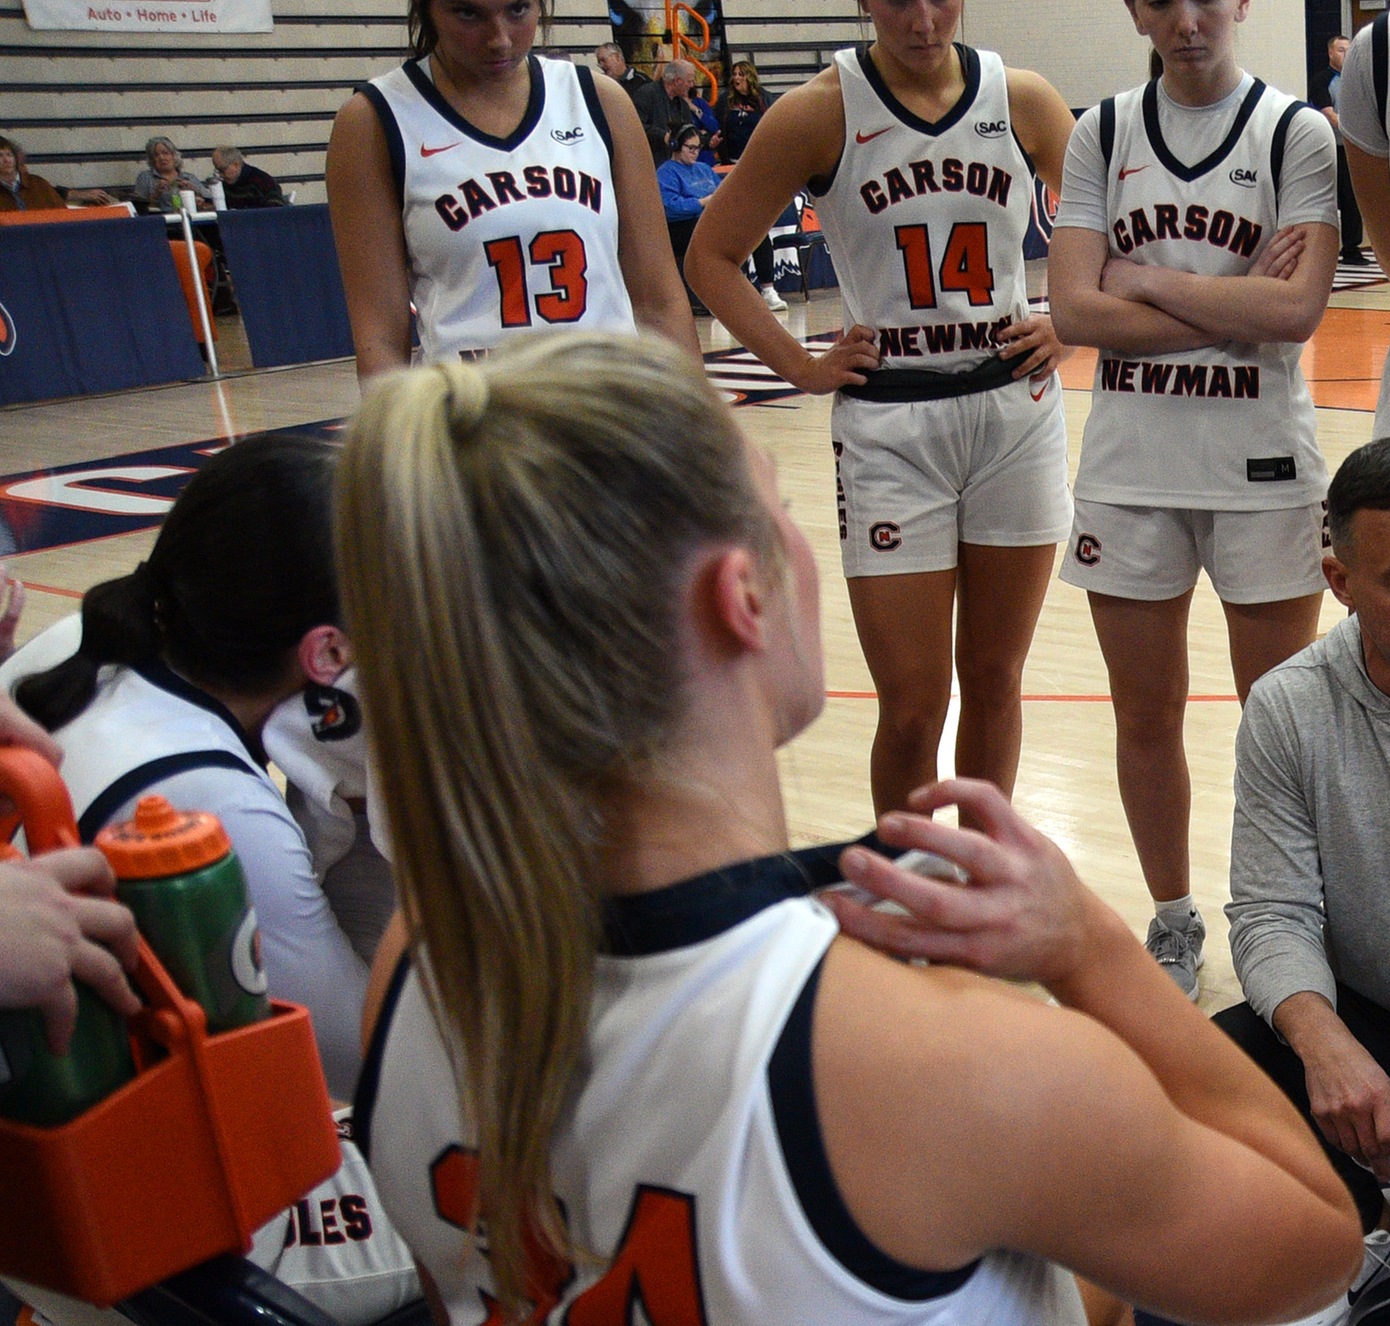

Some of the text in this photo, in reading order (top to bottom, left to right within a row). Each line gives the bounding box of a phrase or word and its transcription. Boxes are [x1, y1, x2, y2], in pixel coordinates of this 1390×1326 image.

[88, 7, 217, 23] Auto Home Life
[553, 126, 584, 142] SAC
[978, 120, 1007, 134] SAC
[434, 165, 602, 232] CARSON
[860, 158, 1012, 215] CARSON
[1113, 204, 1262, 258] CARSON
[483, 228, 588, 329] 13
[894, 221, 995, 310] 14
[1102, 359, 1260, 399] NEWMAN
[1281, 463, 1290, 473] M
